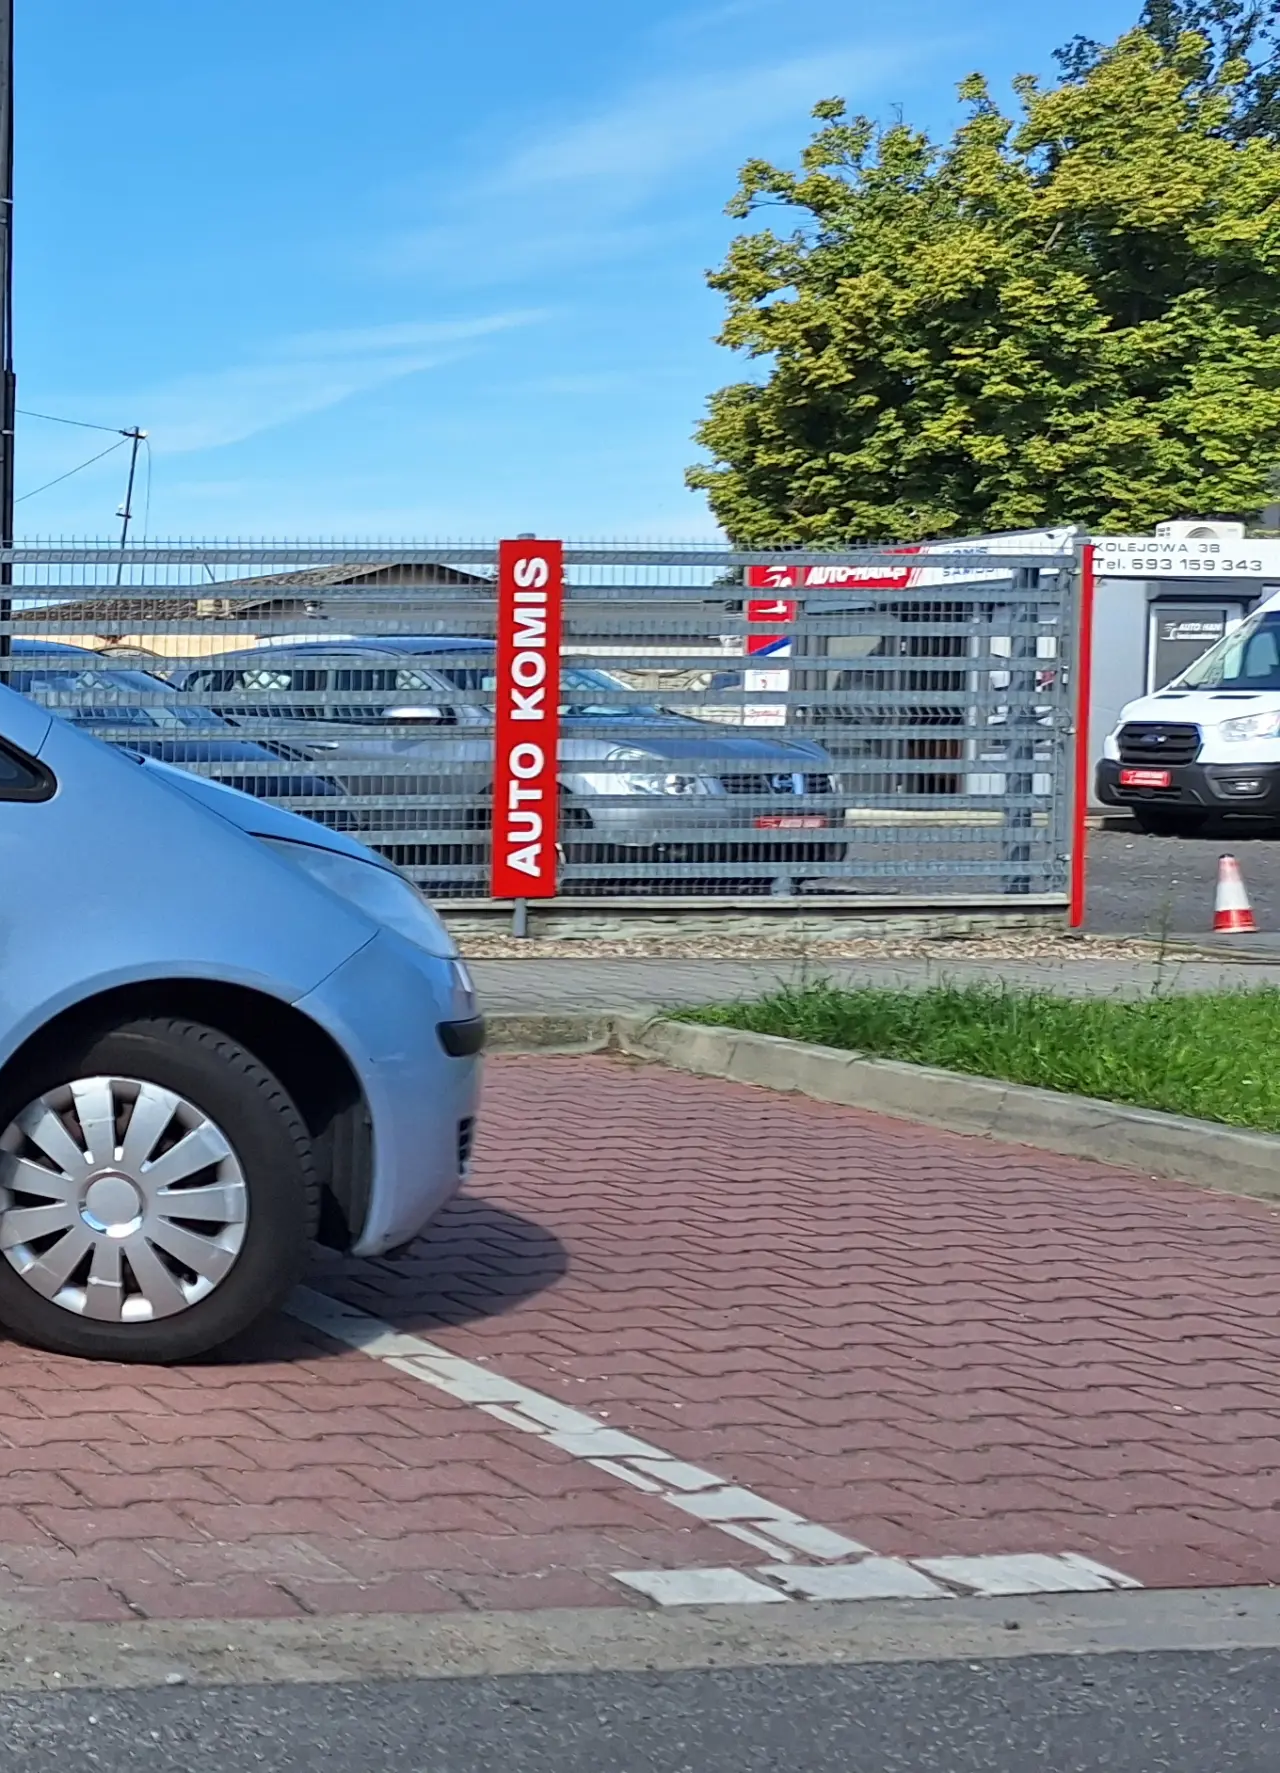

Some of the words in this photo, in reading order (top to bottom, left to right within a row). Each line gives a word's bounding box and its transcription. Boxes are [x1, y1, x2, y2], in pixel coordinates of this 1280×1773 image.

[1091, 557, 1126, 569] Tel.
[1132, 558, 1172, 570] 693
[1180, 558, 1216, 571] 159
[1221, 559, 1263, 571] 343
[1092, 542, 1189, 553] KOLEJOWA
[510, 557, 549, 721] KOMIS
[506, 743, 545, 877] AUTO
